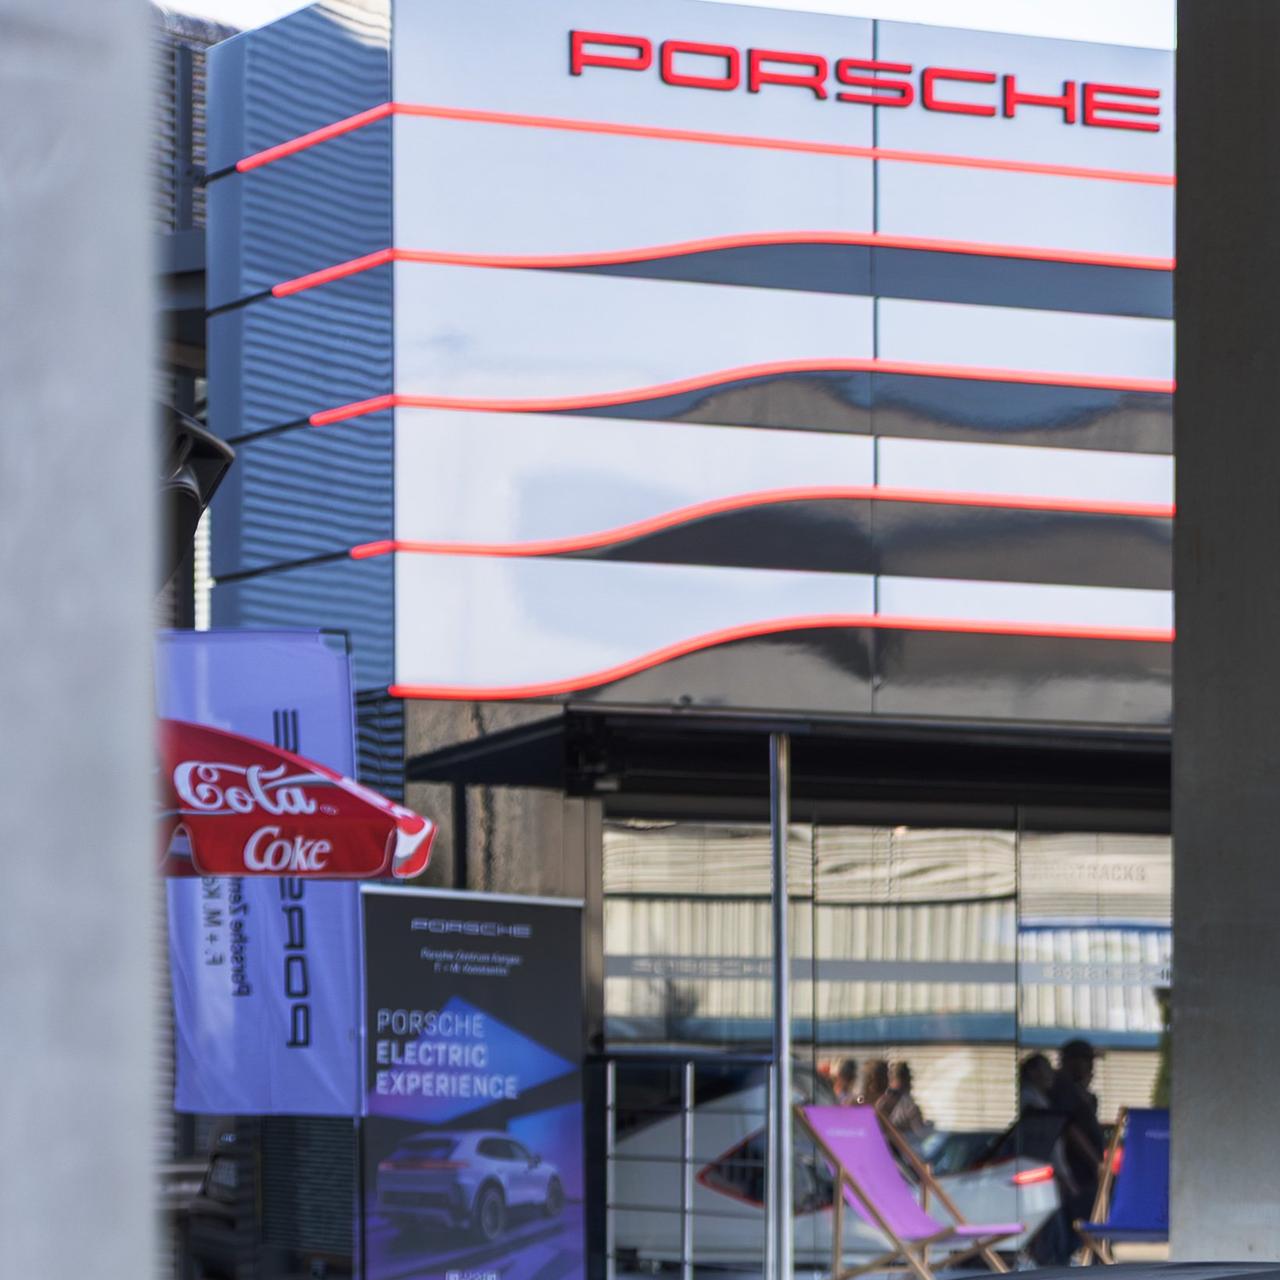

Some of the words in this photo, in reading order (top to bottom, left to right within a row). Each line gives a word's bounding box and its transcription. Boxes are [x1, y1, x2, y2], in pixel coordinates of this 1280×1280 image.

[569, 29, 1161, 132] PORSCHE
[173, 761, 317, 816] Cola
[243, 825, 332, 871] Coke
[411, 917, 531, 938] PORSCHE
[376, 1008, 485, 1038] PORSCHE
[376, 1040, 488, 1068] ELECTRIC
[376, 1071, 518, 1099] EXPERIENCE
